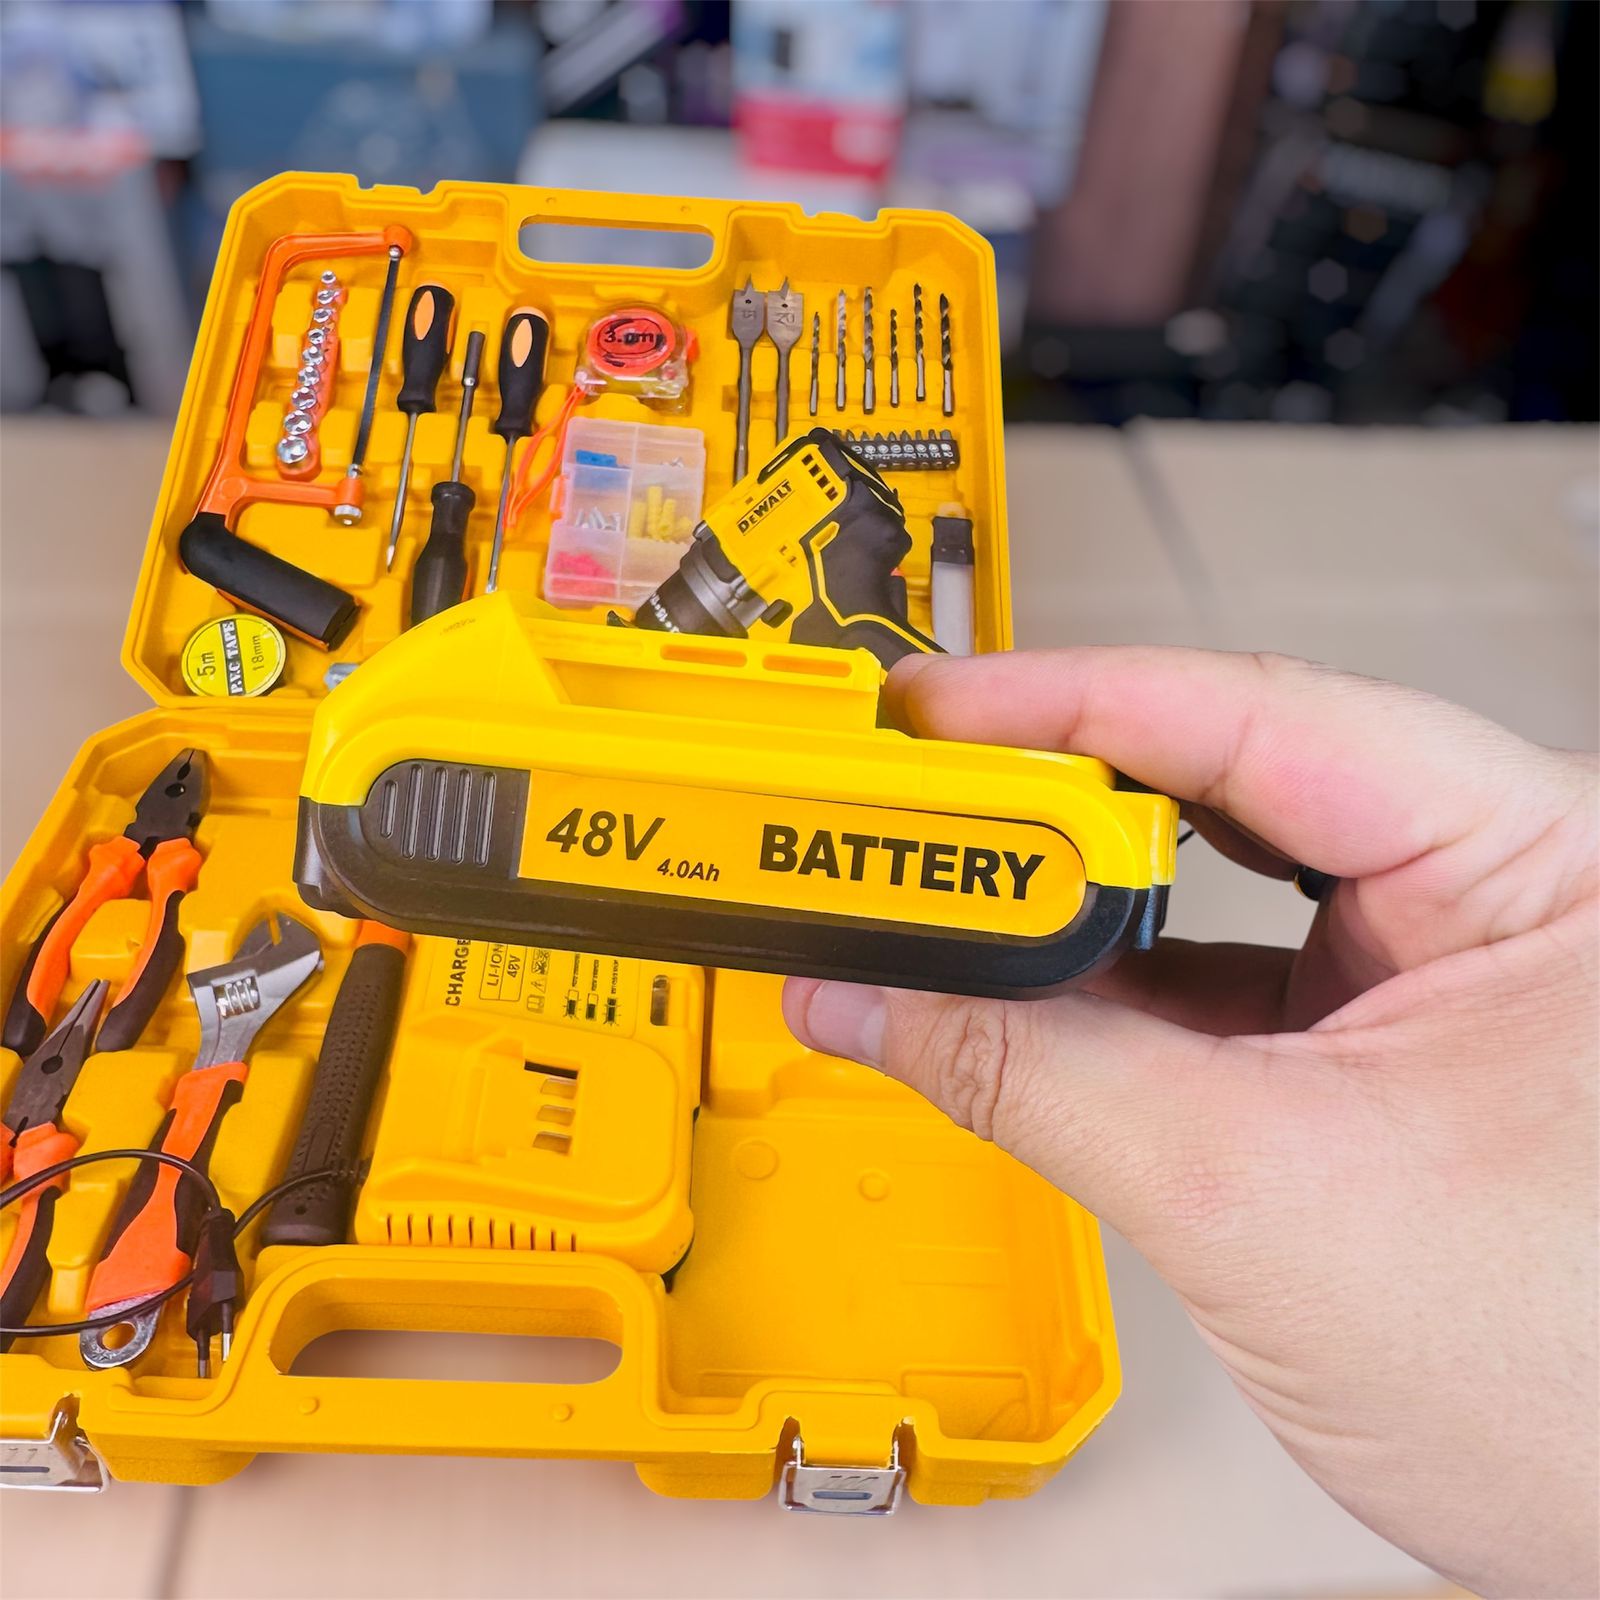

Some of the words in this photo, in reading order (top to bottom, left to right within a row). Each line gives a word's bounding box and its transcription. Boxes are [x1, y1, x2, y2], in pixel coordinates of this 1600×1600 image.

[222, 621, 239, 659] TAPE
[252, 635, 264, 671] 18mm
[197, 652, 216, 676] 5m
[546, 807, 666, 862] 48V
[657, 858, 721, 882] 4.0Ah
[759, 823, 1045, 900] BATTERY
[506, 954, 521, 979] 48V
